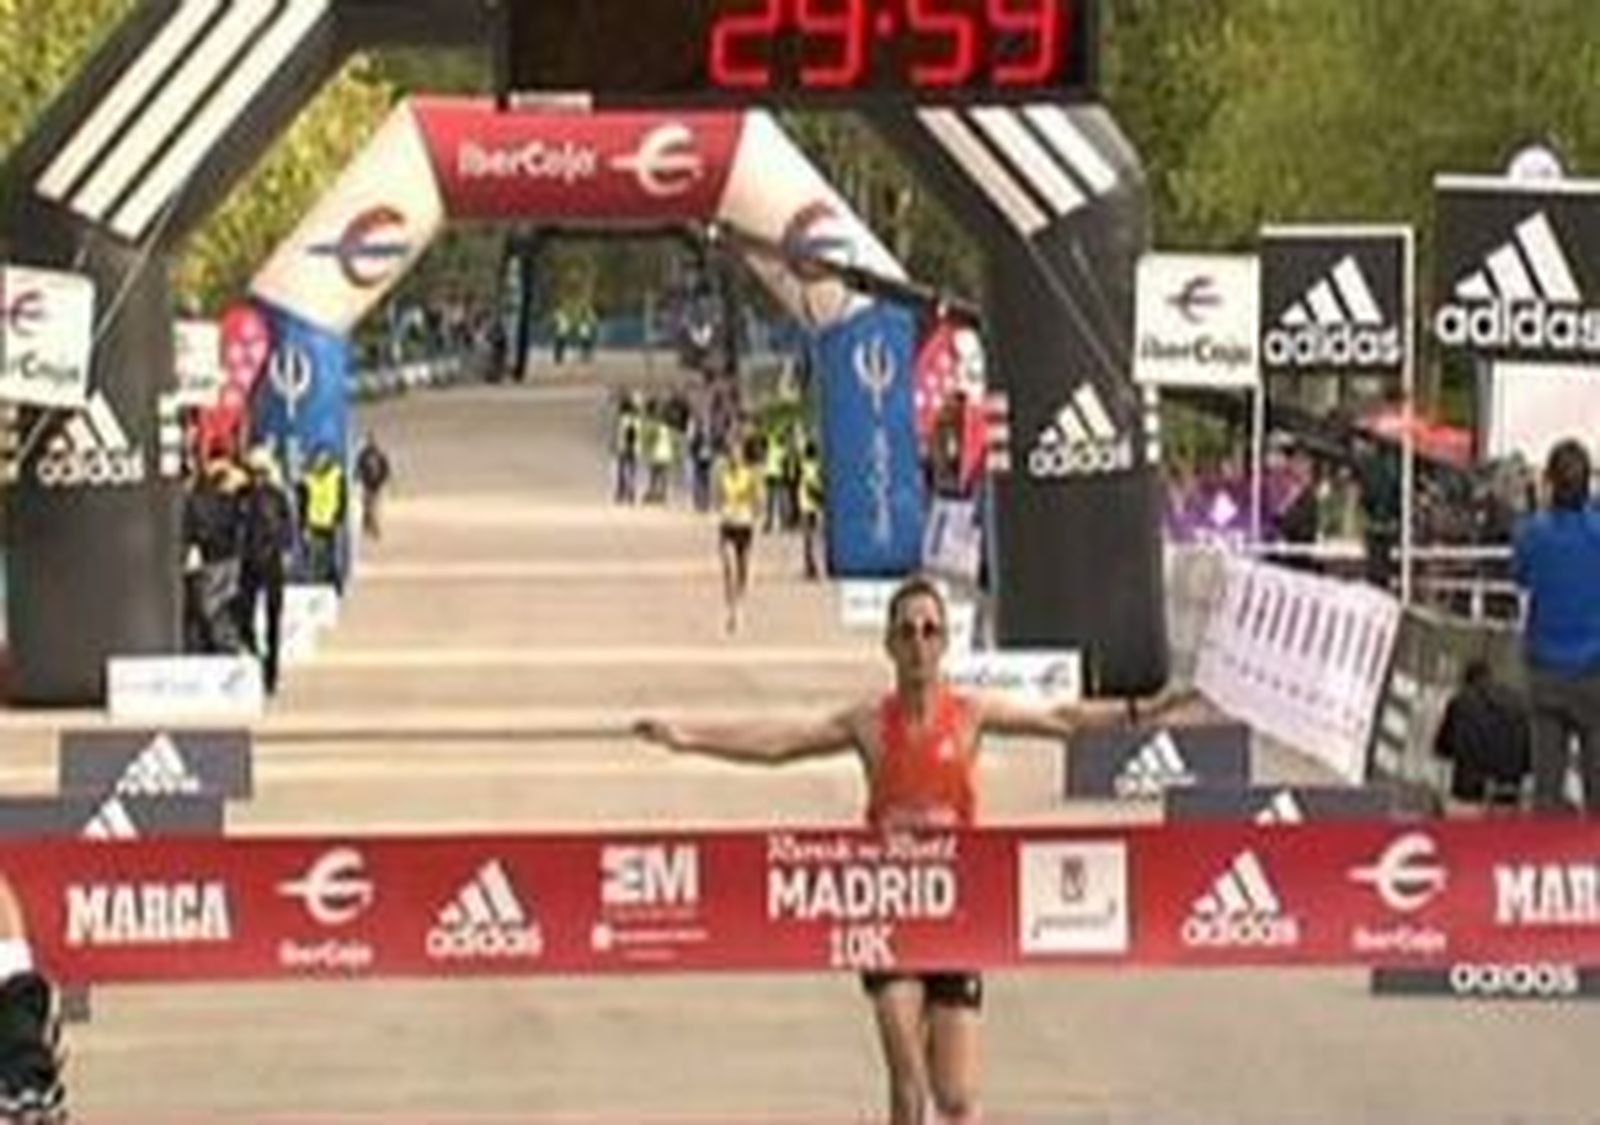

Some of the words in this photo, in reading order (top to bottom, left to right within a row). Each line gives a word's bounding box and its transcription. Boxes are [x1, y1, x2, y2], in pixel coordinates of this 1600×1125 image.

[1264, 322, 1401, 367] adidas
[36, 448, 145, 485] adidas
[1028, 431, 1133, 478] adidas
[65, 882, 231, 944] MARCA
[767, 867, 957, 919] MADRID
[426, 921, 543, 957] adidas
[830, 925, 898, 967] 10K
[1181, 916, 1298, 945] adidas
